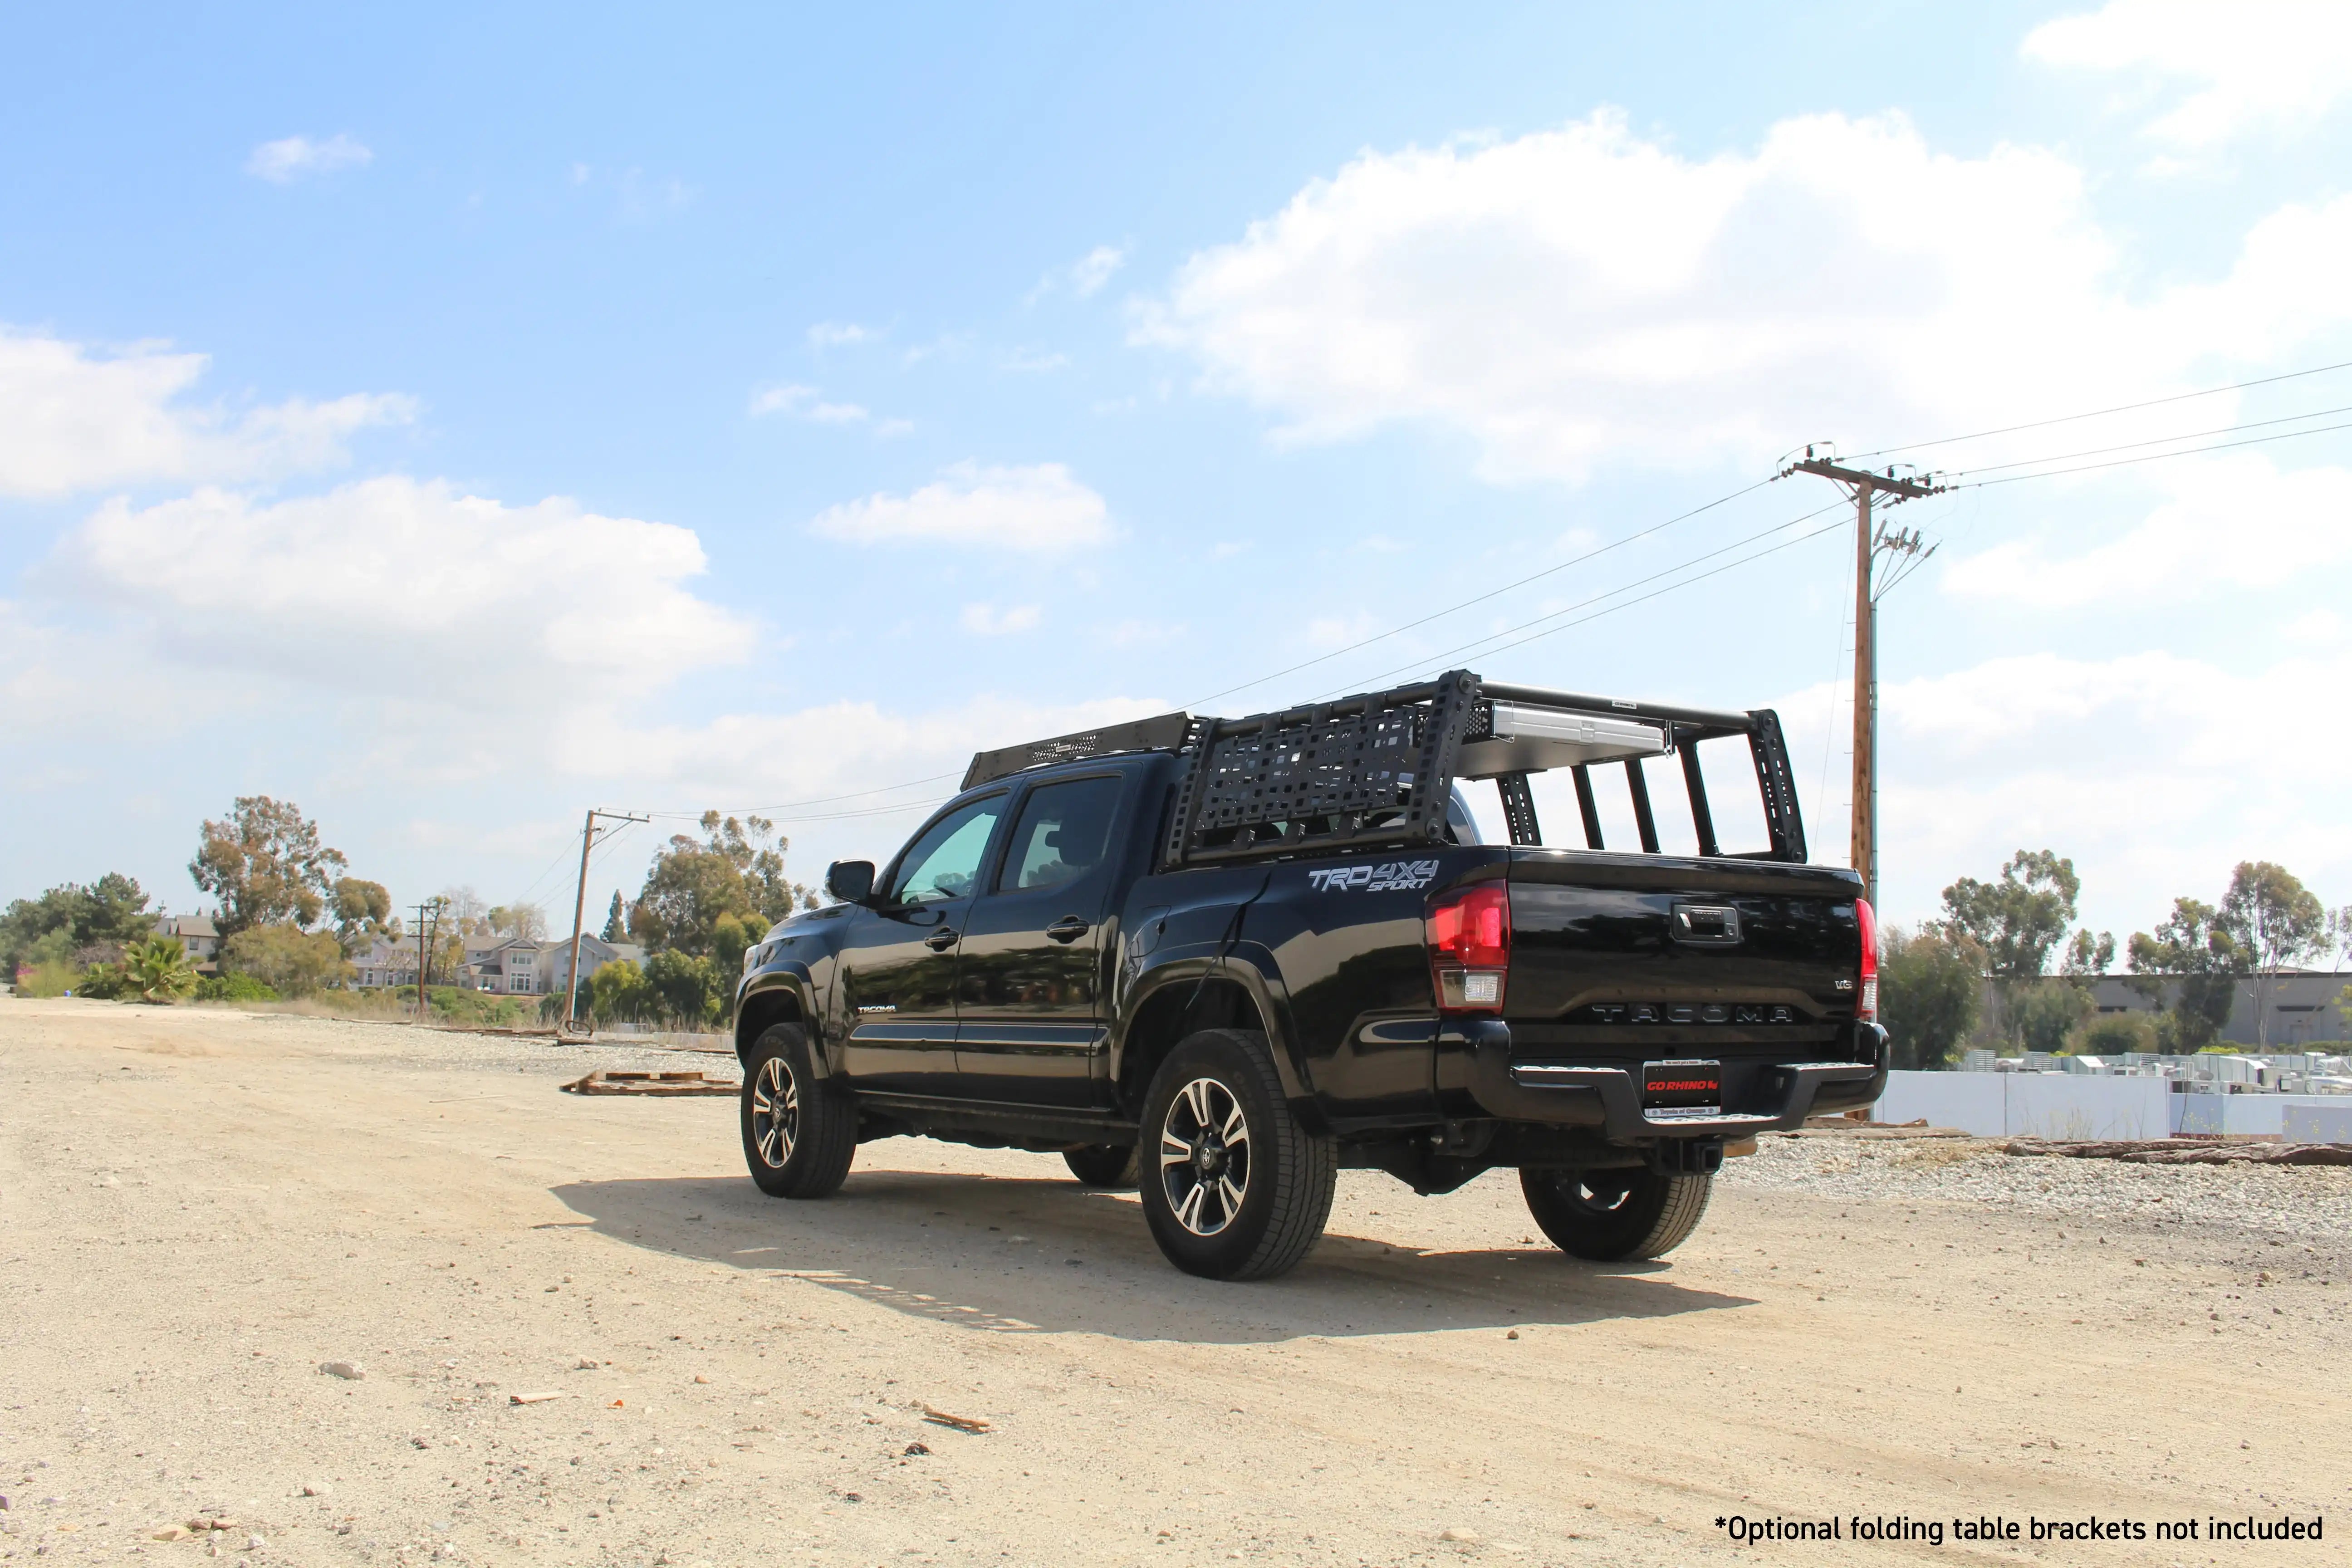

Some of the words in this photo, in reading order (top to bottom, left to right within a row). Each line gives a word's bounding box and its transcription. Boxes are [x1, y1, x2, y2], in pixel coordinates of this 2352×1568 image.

[1308, 865, 1373, 893] TRD
[1373, 860, 1440, 881] 4X4
[1366, 878, 1432, 892] SPORT
[1834, 980, 1852, 989] V6
[858, 1005, 897, 1013] TACOMA
[1591, 1004, 1793, 1022] TACOMA
[1647, 1082, 1666, 1091] GO
[1666, 1081, 1707, 1090] RHINO
